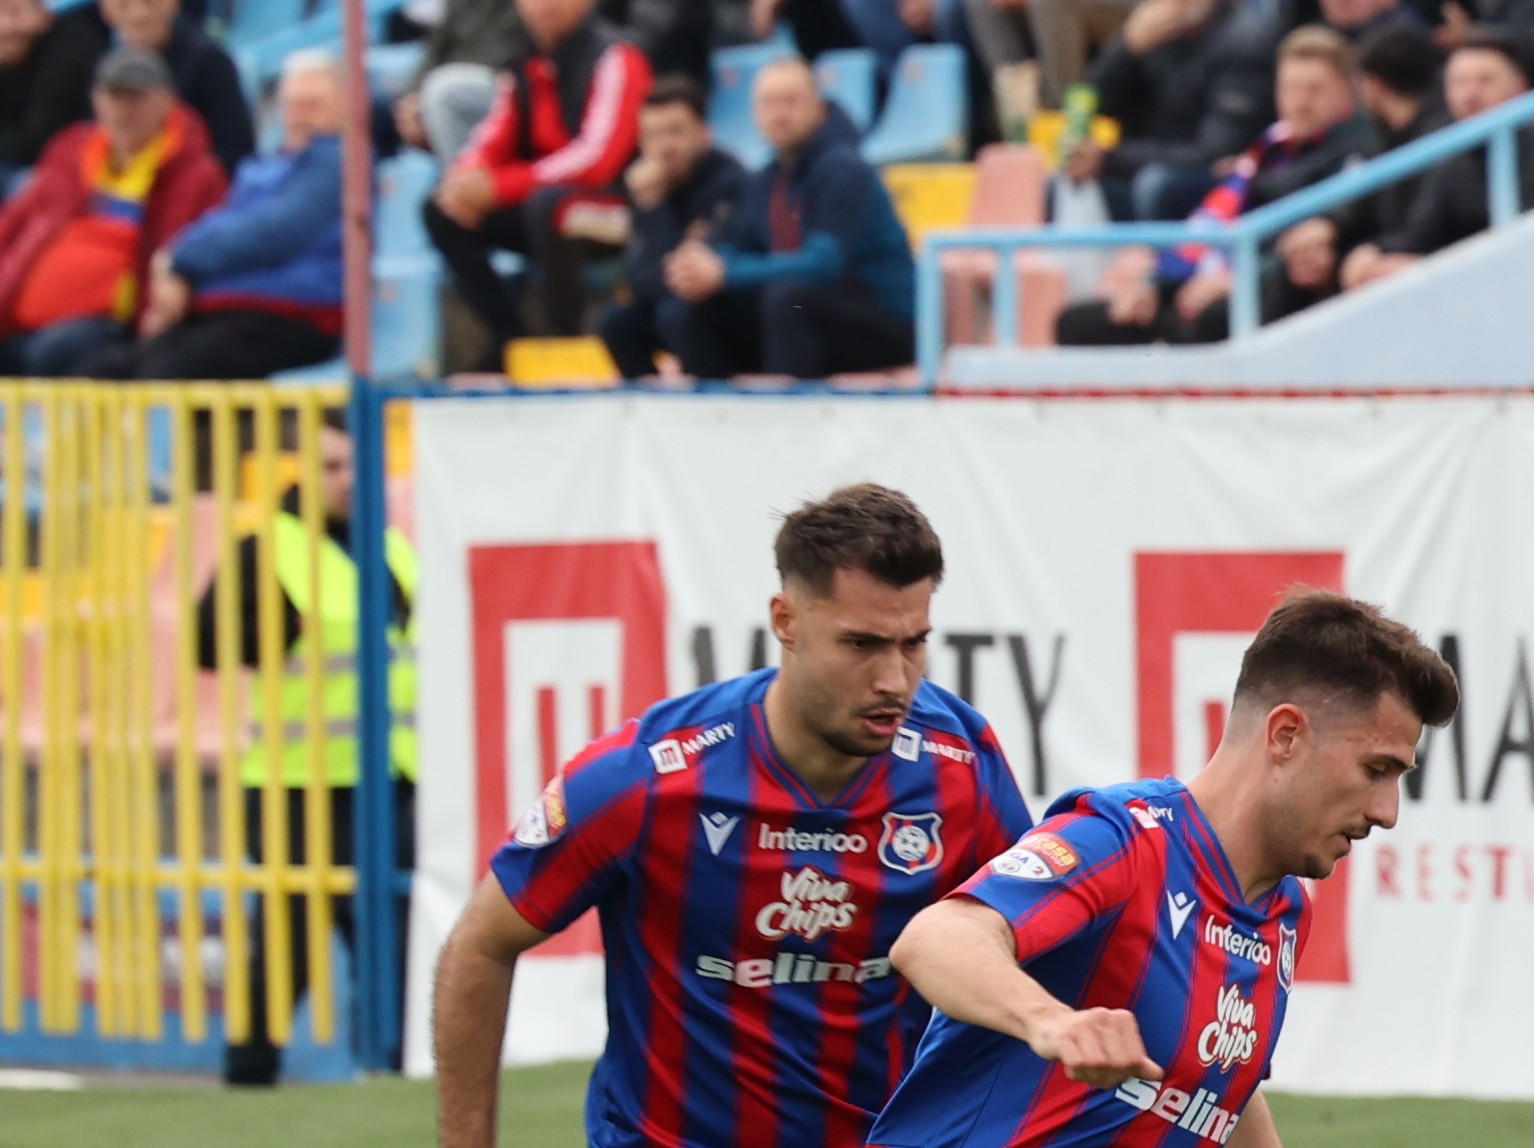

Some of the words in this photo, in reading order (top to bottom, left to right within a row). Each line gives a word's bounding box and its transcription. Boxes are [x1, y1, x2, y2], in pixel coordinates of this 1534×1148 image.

[780, 866, 851, 903] Viva
[755, 900, 858, 941] Chips
[695, 952, 893, 989] selina
[1217, 983, 1255, 1030] Viva
[1198, 1018, 1258, 1071] Chips
